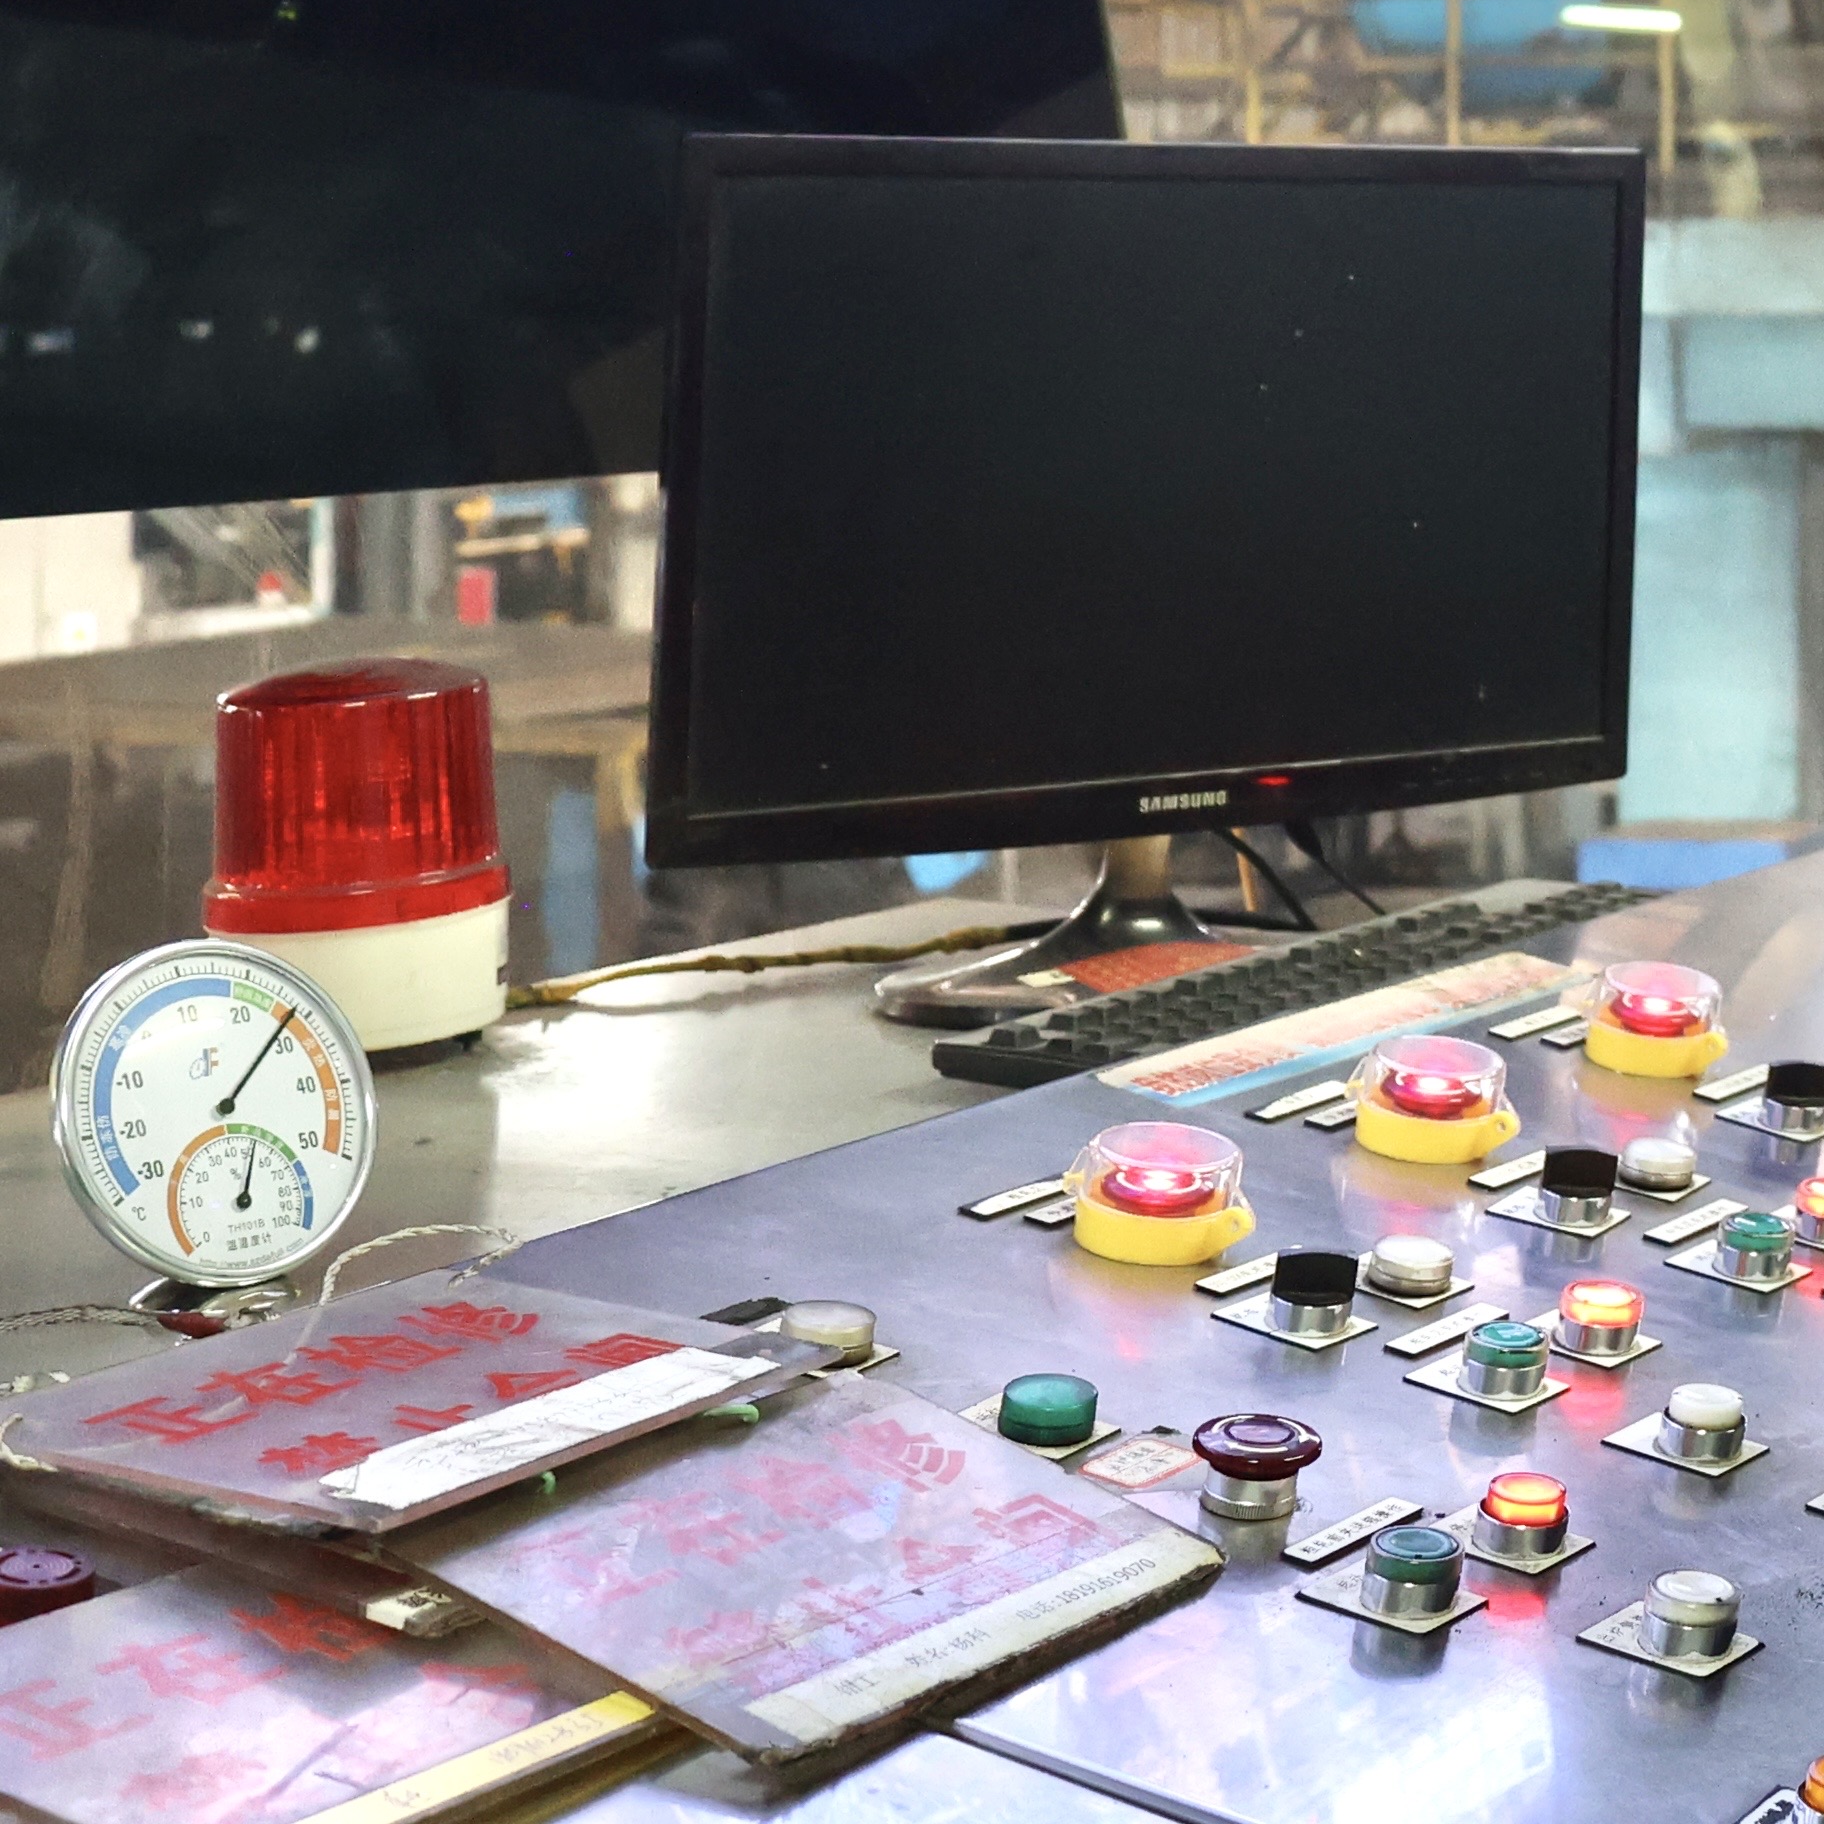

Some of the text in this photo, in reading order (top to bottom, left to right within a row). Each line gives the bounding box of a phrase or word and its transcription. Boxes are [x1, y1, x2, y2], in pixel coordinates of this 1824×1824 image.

[1139, 789, 1227, 814] SAMSUNG
[177, 1004, 198, 1023] 10
[230, 1006, 250, 1024] 20
[274, 1035, 294, 1055] 30
[116, 1070, 144, 1090] -10
[296, 1075, 316, 1094] 40
[119, 1119, 147, 1138] -20
[299, 1130, 319, 1150] 50
[225, 1146, 237, 1159] 40
[137, 1159, 164, 1180] -30
[209, 1156, 222, 1168] 30
[258, 1156, 272, 1168] 60
[195, 1171, 209, 1184] 20
[271, 1170, 285, 1181] 70
[278, 1186, 292, 1198] 80
[189, 1196, 203, 1208] 10
[280, 1200, 293, 1211] 90
[272, 1214, 291, 1227] 100
[84, 1301, 539, 1444] 正在检修
